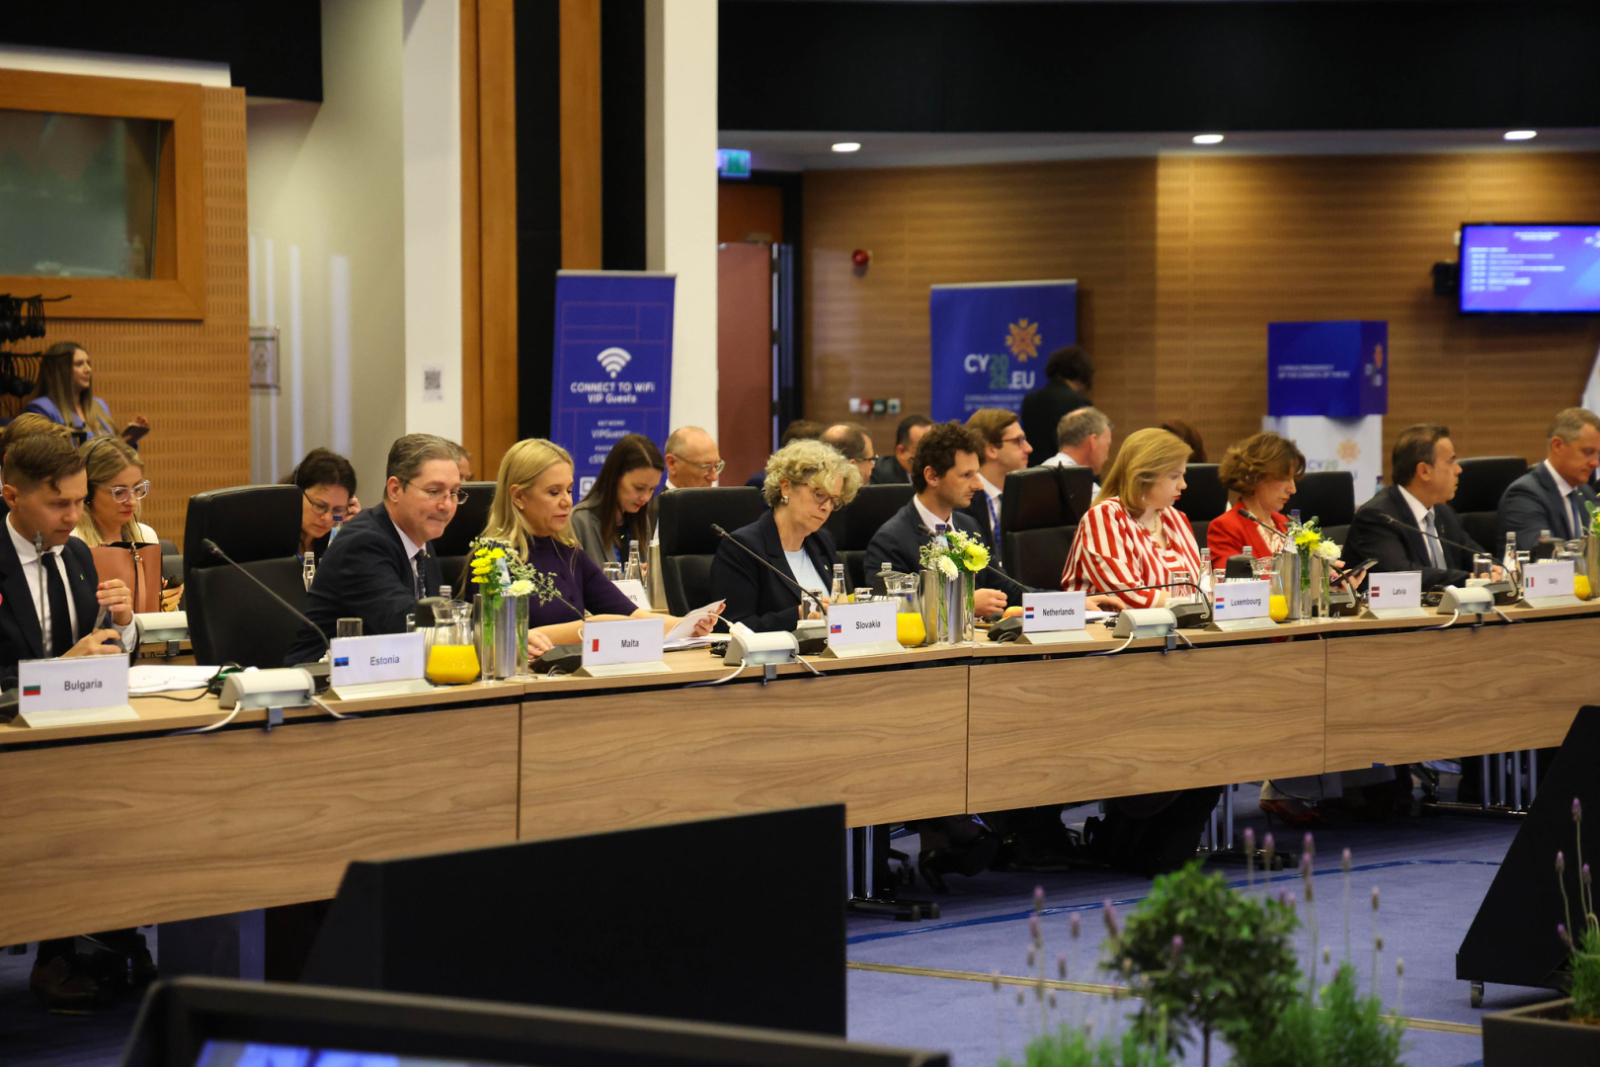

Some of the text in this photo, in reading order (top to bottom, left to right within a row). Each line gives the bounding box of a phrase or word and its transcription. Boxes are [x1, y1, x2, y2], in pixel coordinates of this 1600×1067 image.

[570, 382, 615, 393] CONNECT
[618, 382, 631, 392] TO
[588, 393, 637, 403] VIP Guests
[591, 430, 630, 438] VIPGuests
[1392, 587, 1407, 596] Latvia
[1230, 597, 1261, 607] Luxembourg
[1042, 607, 1075, 617] Netherlands
[855, 620, 881, 630] Slovakia
[621, 639, 639, 648] Malta
[370, 655, 399, 666] Estonia
[64, 679, 102, 692] Bulgaria
